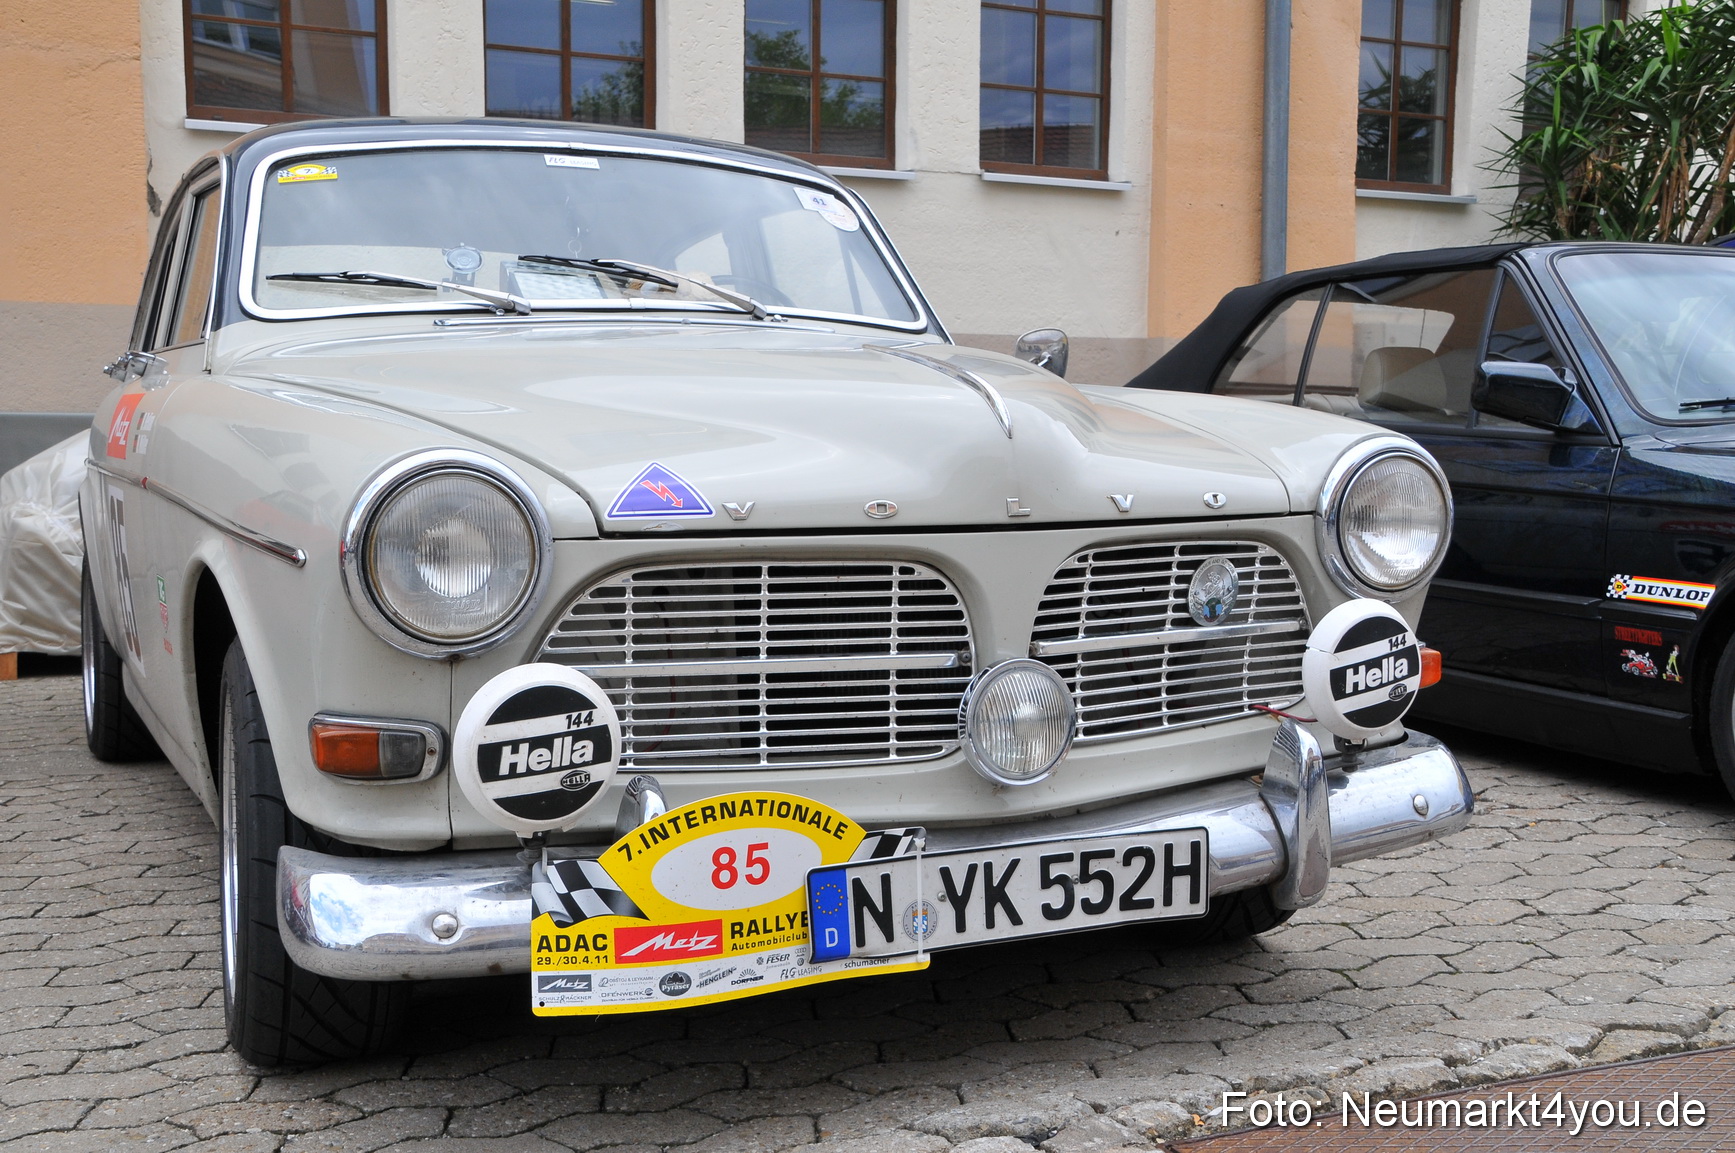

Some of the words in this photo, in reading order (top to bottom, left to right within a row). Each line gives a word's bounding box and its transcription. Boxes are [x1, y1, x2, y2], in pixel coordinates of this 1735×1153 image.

[1632, 583, 1711, 602] DUNLOP
[1388, 634, 1407, 651] 144
[1345, 656, 1408, 694] Hella
[566, 711, 594, 730] 144
[499, 736, 594, 776] Hella
[562, 773, 591, 785] HELLA
[711, 842, 771, 890] 85
[852, 873, 894, 948] N
[939, 858, 1023, 934] YK
[1040, 840, 1201, 921] 552H
[730, 911, 809, 939] RALLYE
[536, 934, 608, 953] ADAC
[620, 930, 718, 958] Metz
[731, 931, 809, 951] Automobilclub
[825, 927, 839, 948] D
[537, 955, 609, 966] 29./30.4.11
[540, 978, 590, 991] Metz
